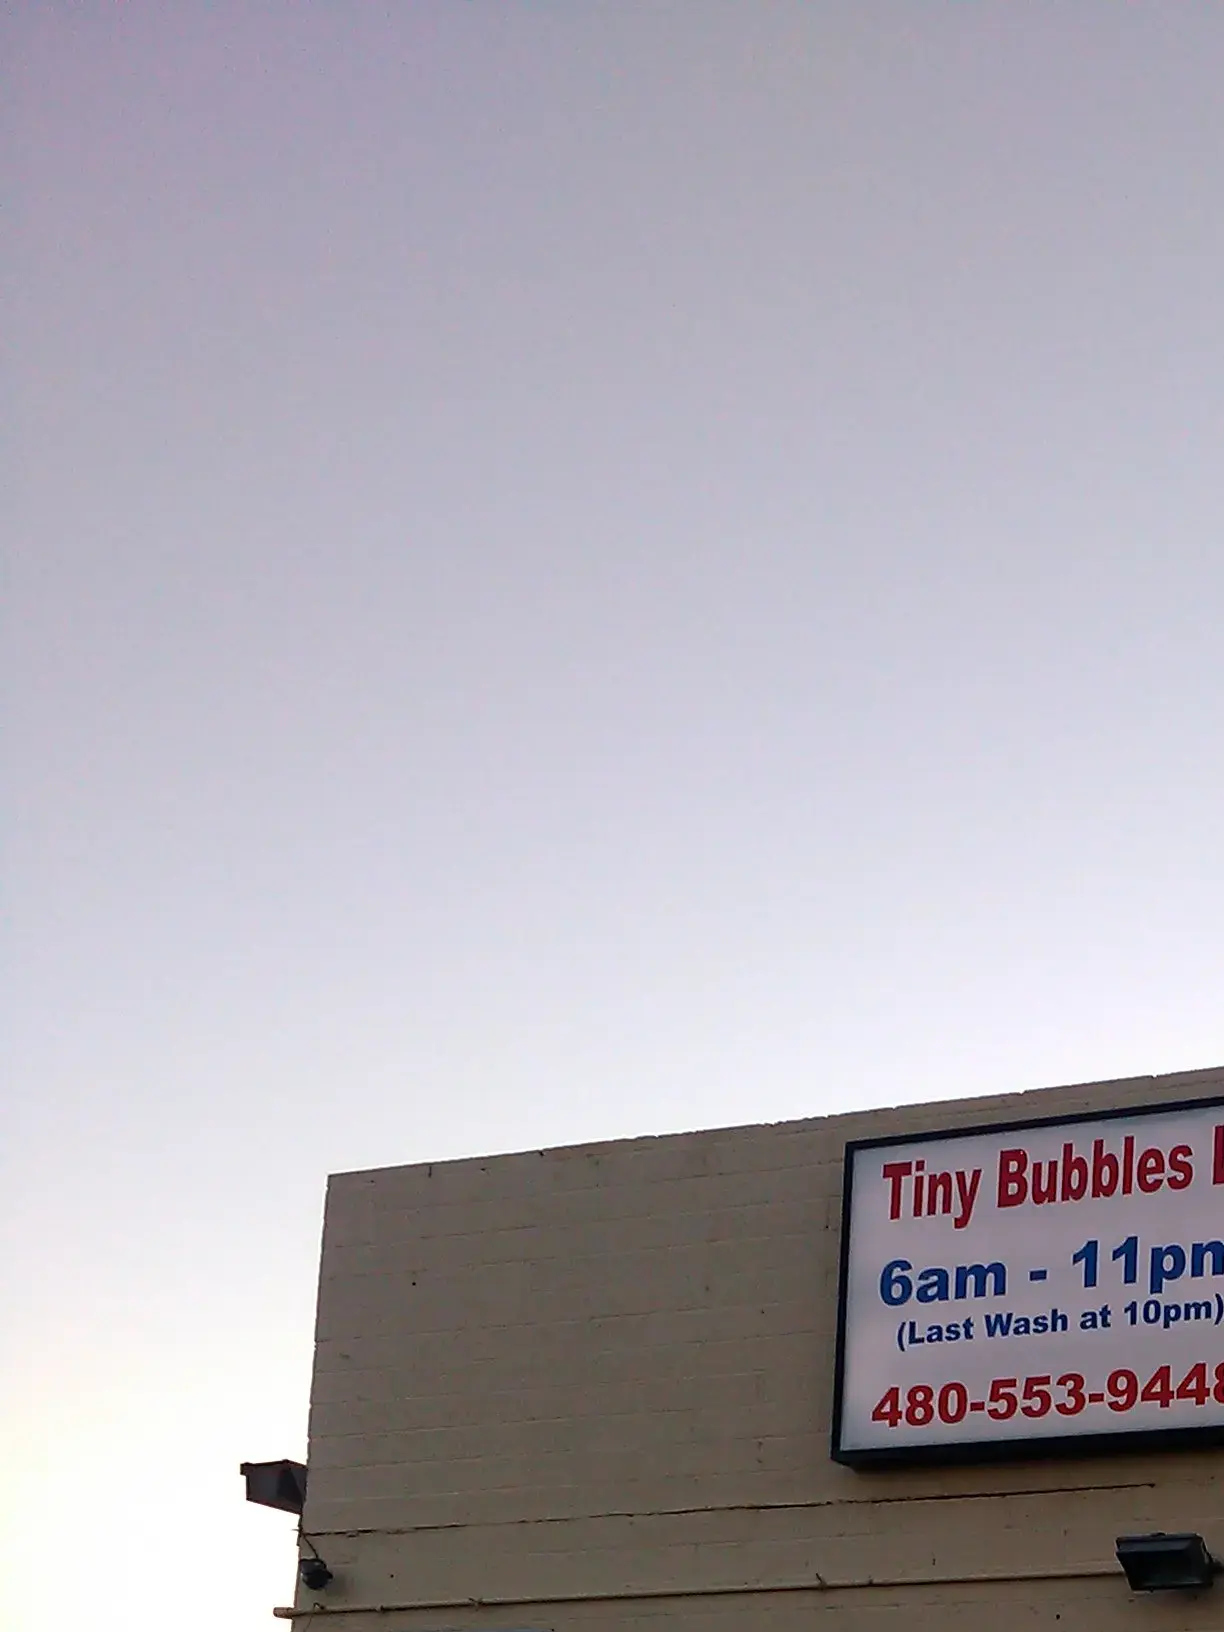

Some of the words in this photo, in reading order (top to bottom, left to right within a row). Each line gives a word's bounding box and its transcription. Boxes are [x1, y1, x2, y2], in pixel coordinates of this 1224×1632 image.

[882, 1161, 982, 1230] Tiny
[997, 1134, 1194, 1210] Bubbles
[879, 1259, 1007, 1307] 6am
[1029, 1268, 1048, 1283] -
[896, 1311, 974, 1352] (Last
[984, 1306, 1069, 1338] Wash
[1079, 1304, 1112, 1330] at
